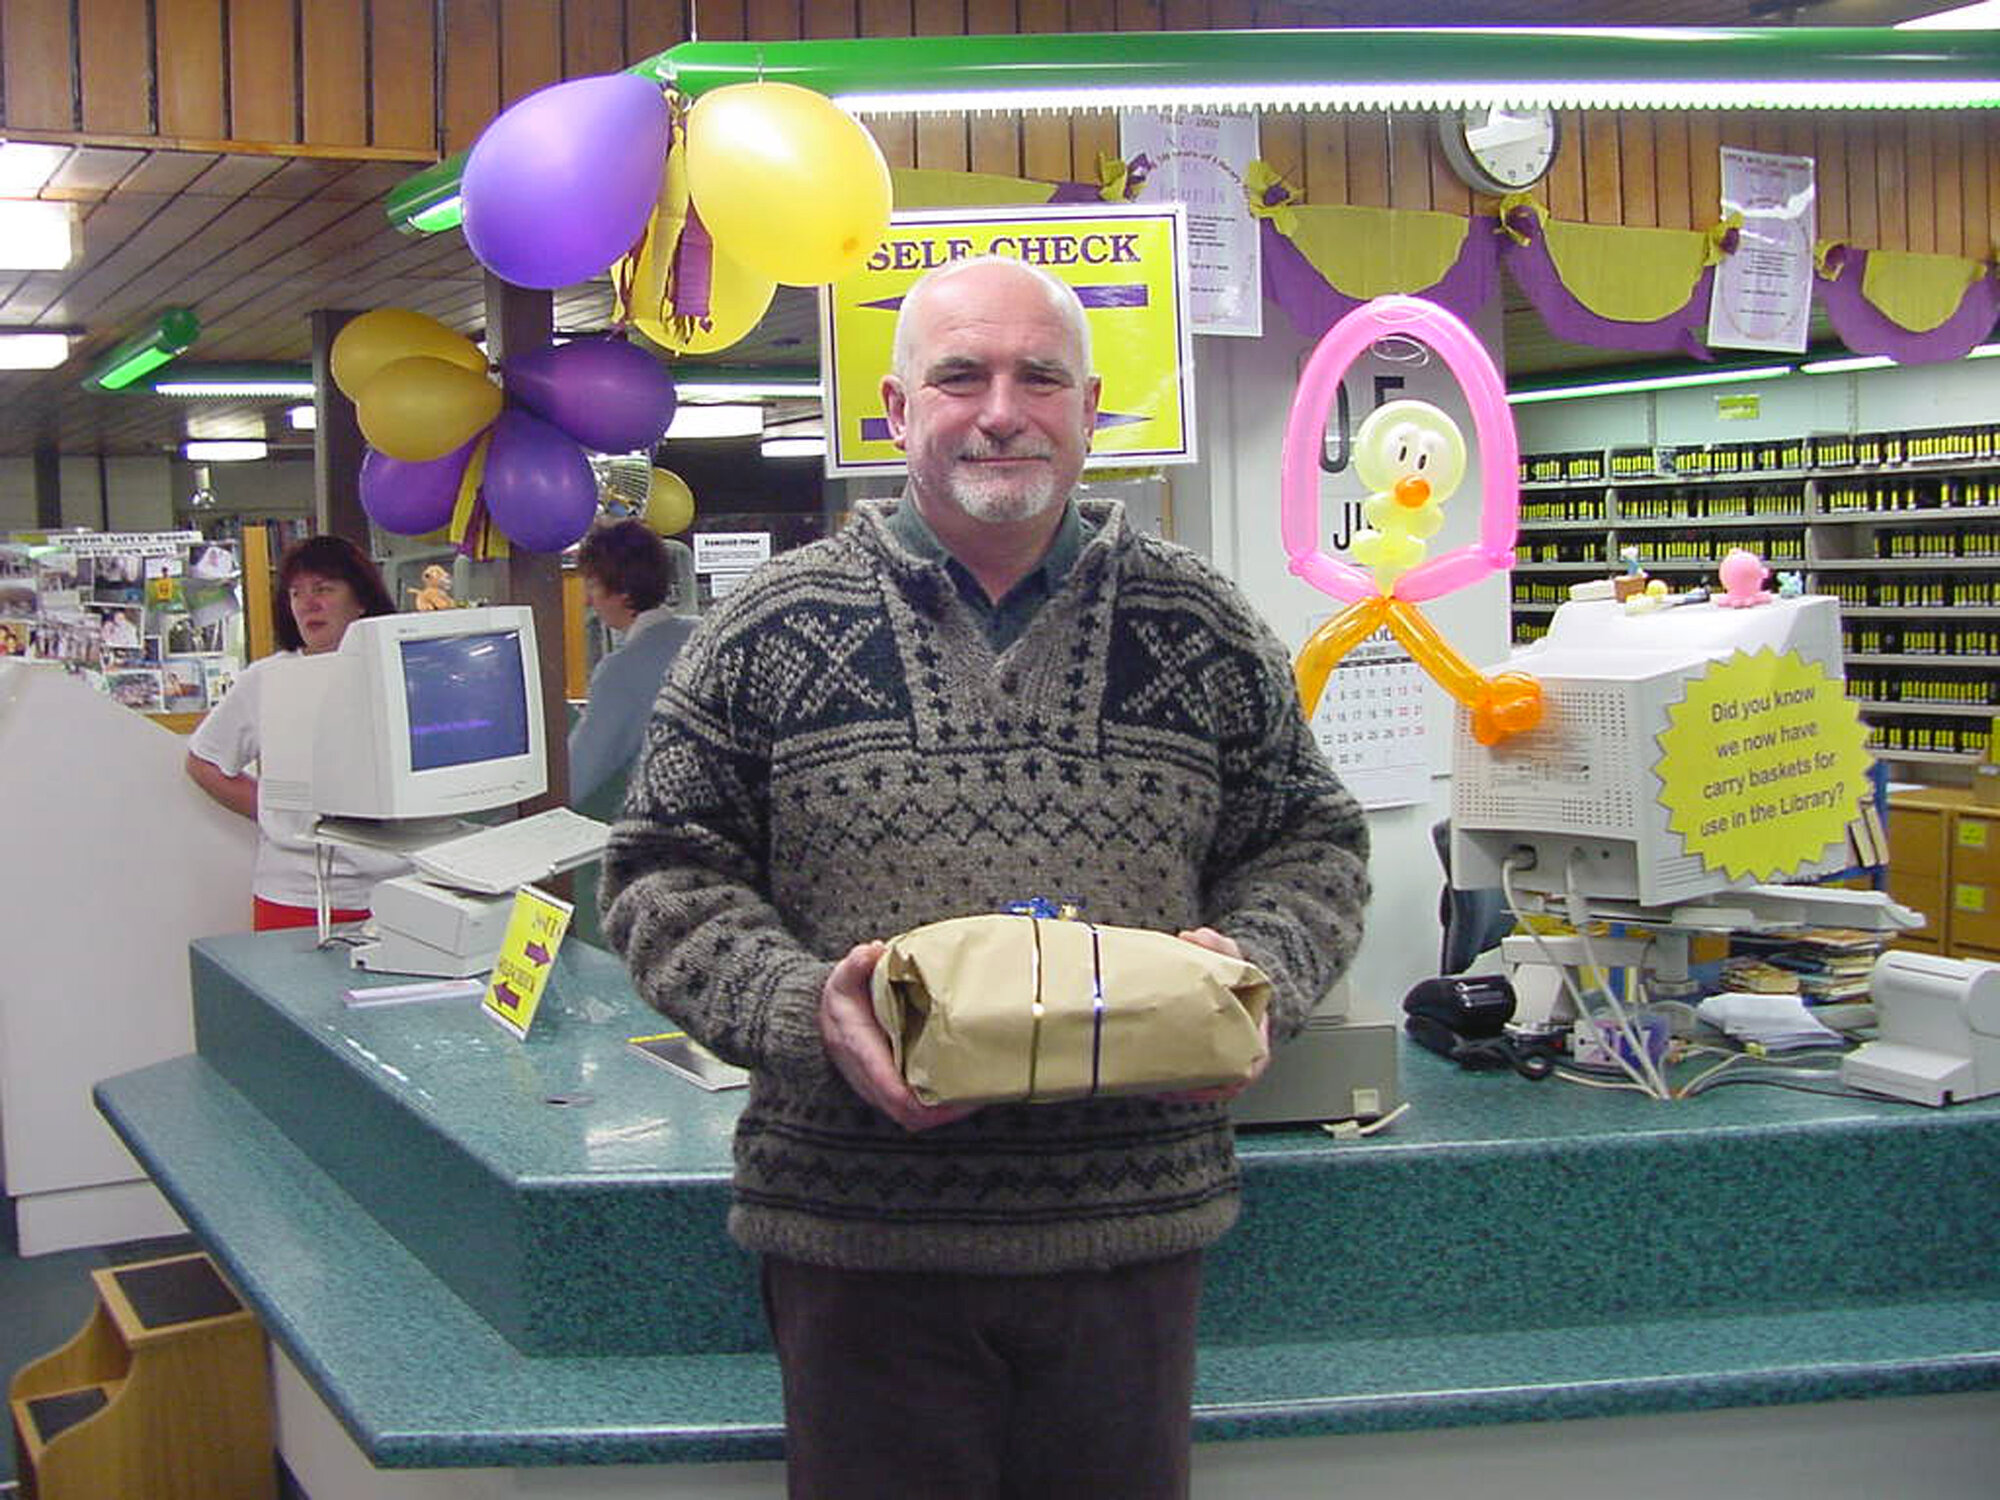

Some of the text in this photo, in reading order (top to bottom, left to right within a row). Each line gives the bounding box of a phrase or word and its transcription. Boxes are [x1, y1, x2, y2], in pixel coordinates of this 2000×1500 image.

[1711, 688, 1815, 723] Did you know
[1717, 721, 1818, 758] we now have
[1703, 751, 1836, 799] carry baskets for
[1701, 781, 1845, 837] use in the Library?
